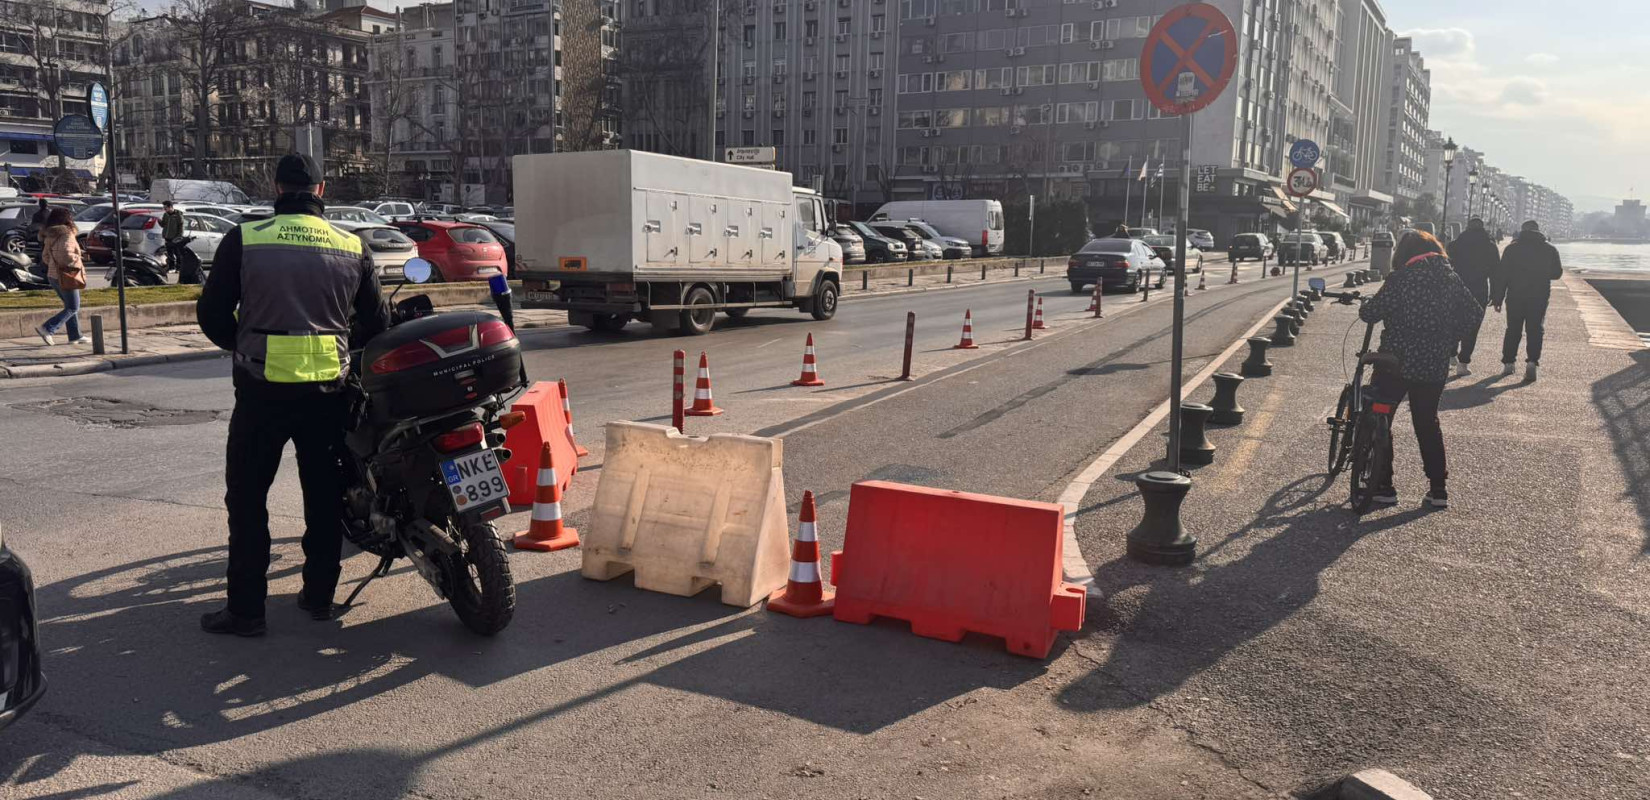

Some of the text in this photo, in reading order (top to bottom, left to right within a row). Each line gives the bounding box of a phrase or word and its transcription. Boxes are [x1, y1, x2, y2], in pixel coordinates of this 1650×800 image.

[1197, 165, 1217, 174] LET
[1197, 174, 1216, 182] EAT
[1197, 183, 1209, 191] BE
[279, 225, 329, 237] ΔΗΜΟΤΙΚΗ
[276, 233, 332, 245] ΑΣΤΥΝΟΜΙΑ
[433, 354, 495, 376] MUNICIPAL POLICE
[457, 453, 496, 479] NKE
[466, 476, 504, 501] 899
